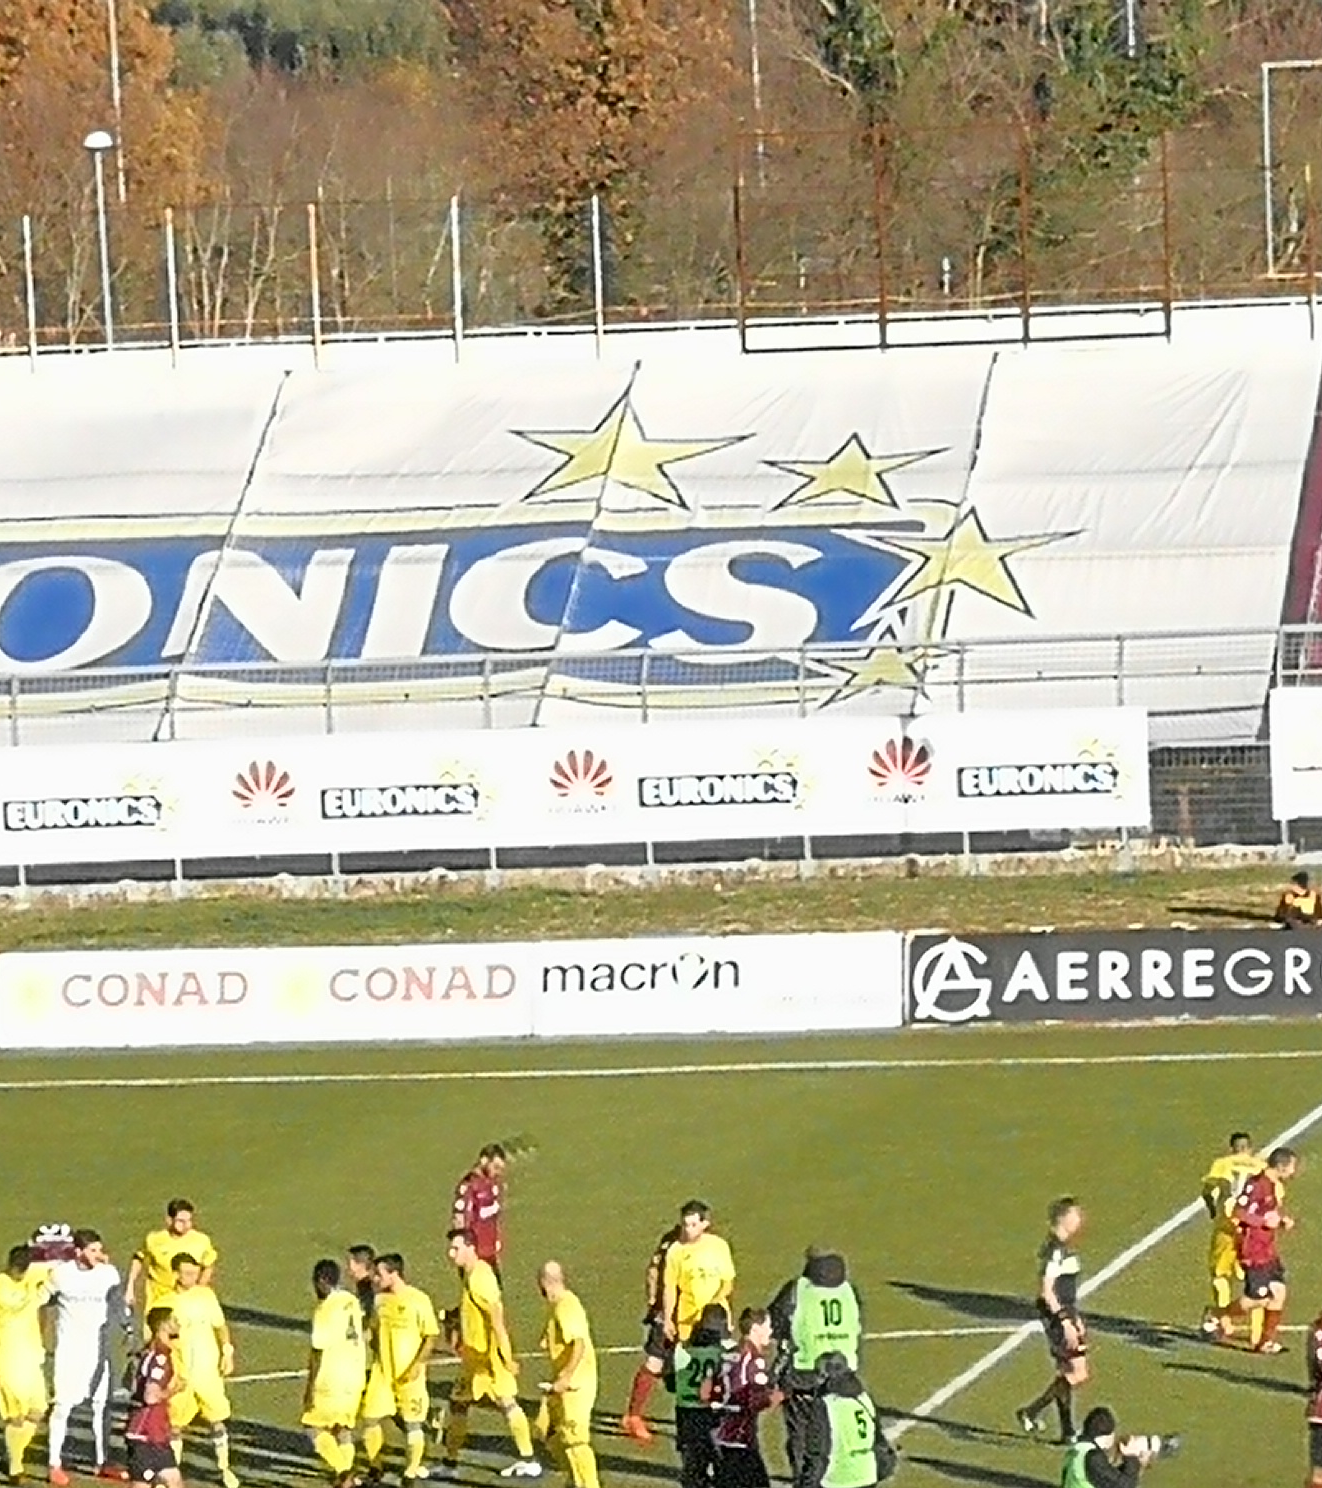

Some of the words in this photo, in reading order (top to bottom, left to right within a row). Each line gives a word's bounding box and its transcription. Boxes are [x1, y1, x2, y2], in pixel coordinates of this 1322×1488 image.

[641, 774, 796, 807] EURONICS
[960, 763, 1114, 796] EURONICS
[5, 797, 160, 831] EURONICS
[324, 786, 477, 819] EURONICS
[61, 970, 251, 1008] CONAD
[329, 964, 517, 1003] CONAD
[542, 953, 741, 992] macron
[820, 1298, 842, 1327] 10
[854, 1410, 868, 1439] 5
